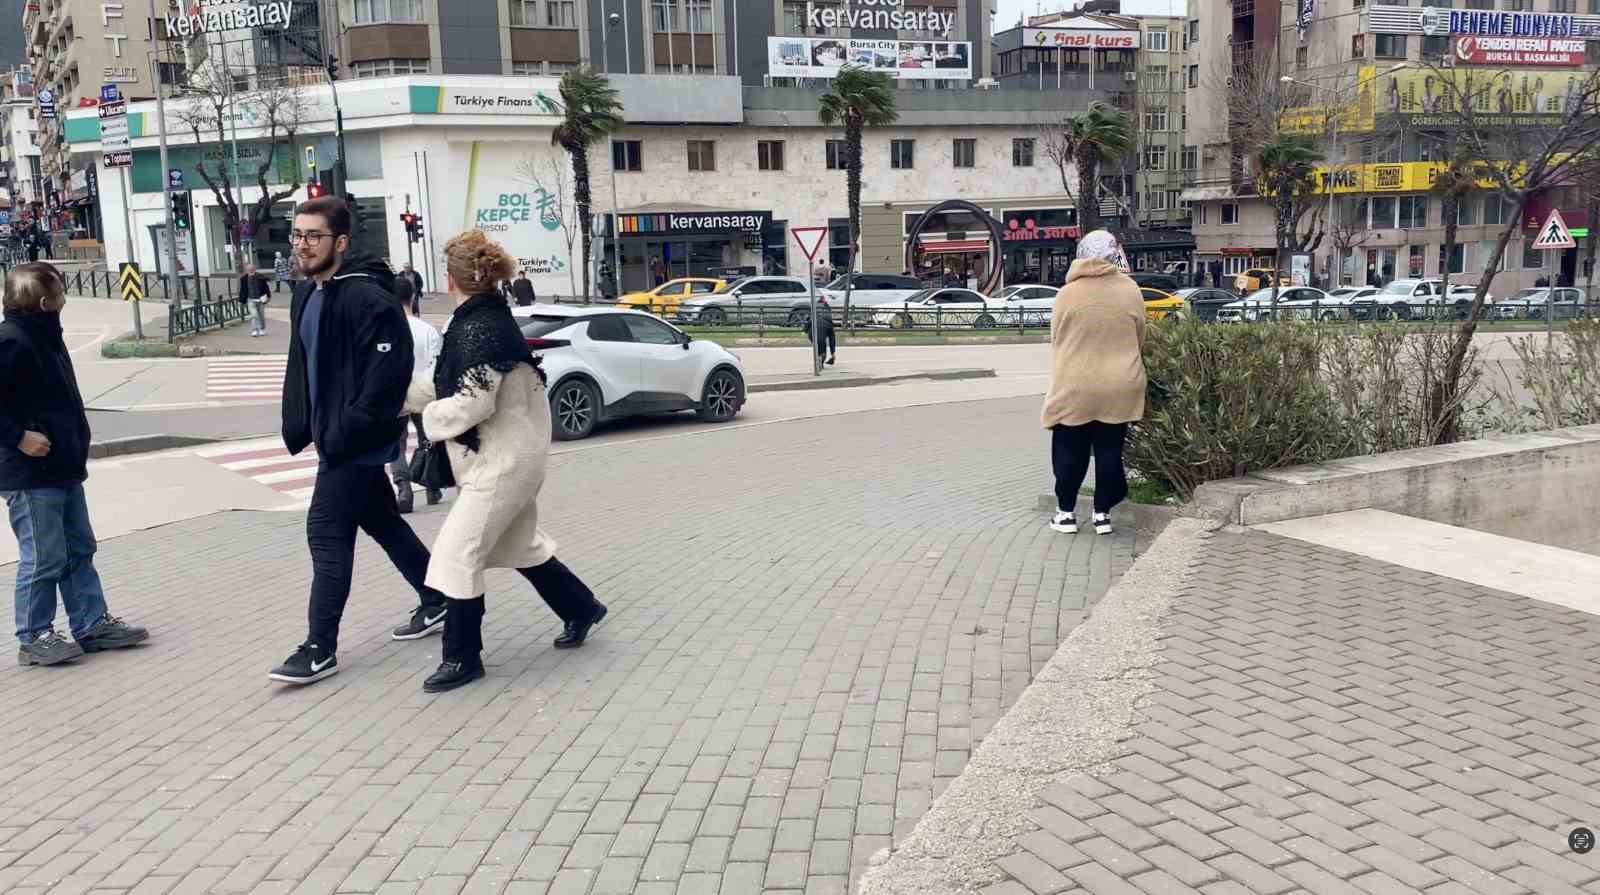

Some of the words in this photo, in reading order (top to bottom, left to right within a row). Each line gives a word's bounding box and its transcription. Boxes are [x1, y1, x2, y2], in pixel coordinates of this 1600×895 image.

[165, 1, 292, 37] kervansaray
[807, 1, 953, 37] kervansaray
[1450, 11, 1507, 36] DENEME
[1512, 14, 1574, 38] DÜNYASI
[850, 41, 875, 50] Bursa
[878, 42, 897, 52] City
[1055, 32, 1090, 46] final
[1095, 34, 1133, 47] kurs
[454, 96, 495, 108] Türkiye
[497, 97, 532, 106] Finans
[499, 193, 530, 207] BOL
[476, 208, 529, 224] KEPÇE
[670, 214, 763, 230] kervansaray
[475, 223, 508, 232] Hesap
[1003, 218, 1040, 240] simit
[518, 257, 548, 267] Türkiye
